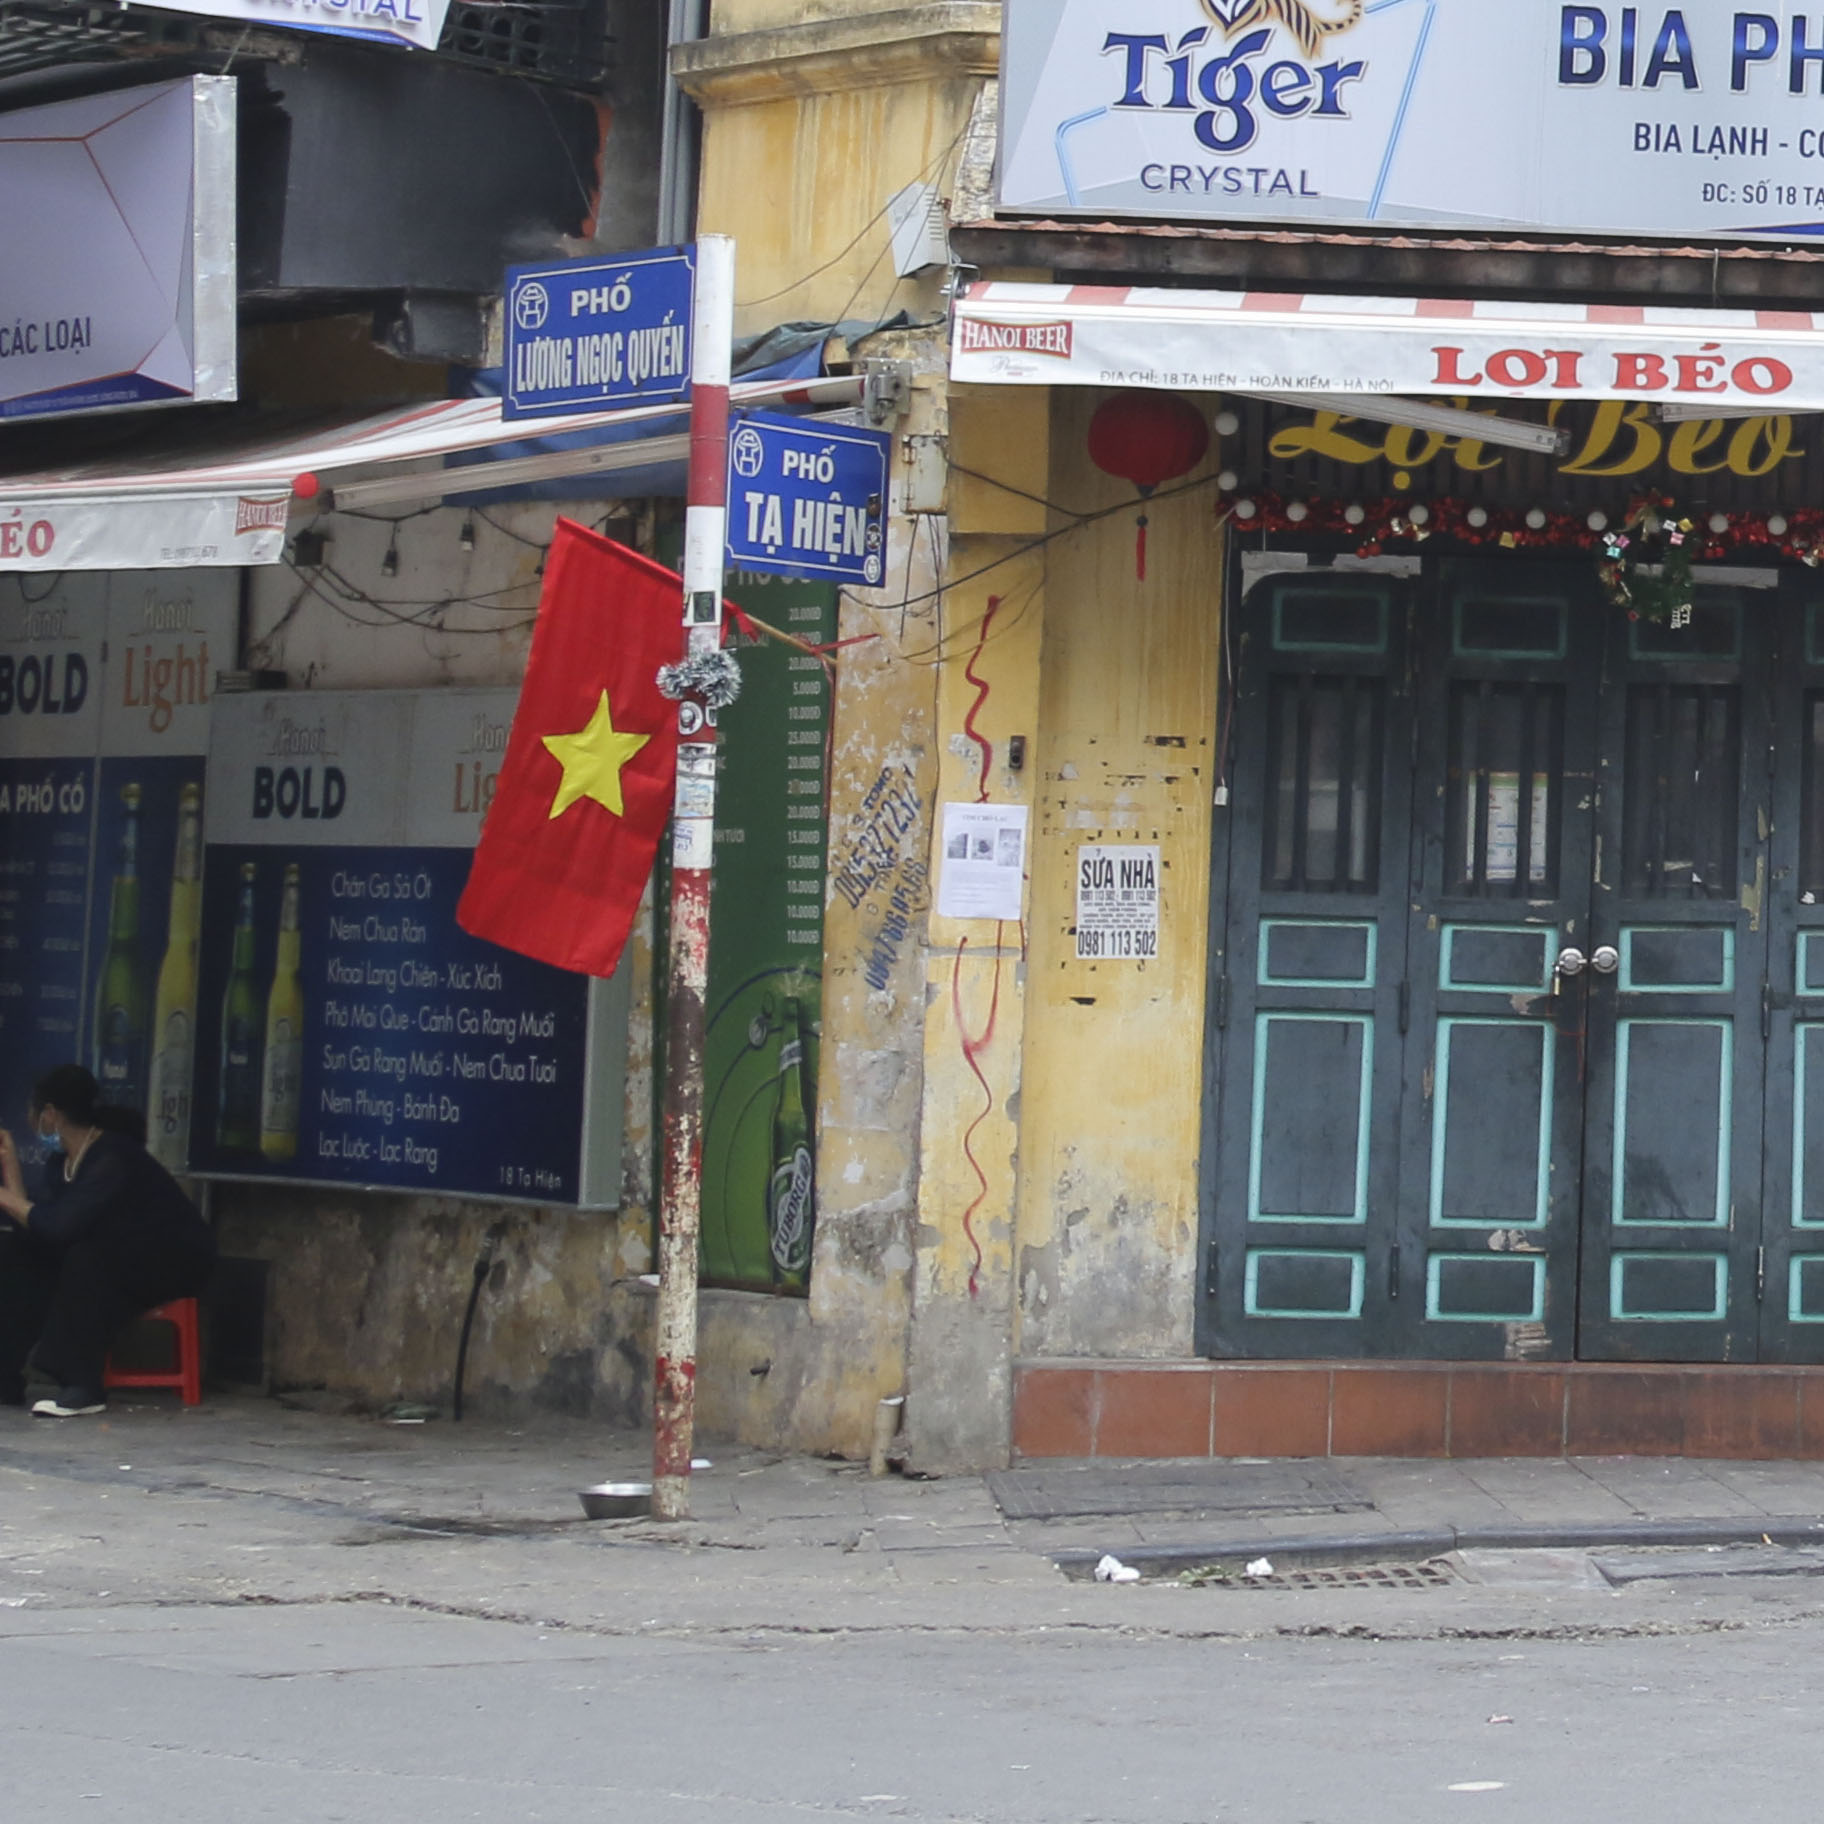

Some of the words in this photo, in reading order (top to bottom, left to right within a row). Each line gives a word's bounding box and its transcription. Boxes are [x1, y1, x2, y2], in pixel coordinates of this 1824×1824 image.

[1557, 3, 1701, 92] BIA
[1101, 26, 1368, 152] Tiger
[1633, 122, 1682, 154] BIA
[1691, 125, 1769, 162] LẠNH
[1140, 163, 1319, 197] CRYSTAL
[1702, 181, 1737, 205] ĐC:
[1742, 177, 1770, 206] SỐ
[1775, 184, 1798, 207] 18
[571, 271, 632, 317] PHỐ
[45, 315, 92, 354] LOẠI
[516, 333, 573, 393] LƯƠNG
[577, 334, 624, 393] NGỌC
[628, 309, 684, 383] QUYẾN
[964, 321, 1023, 352] HANOI
[1025, 324, 1069, 354] BEER
[1163, 373, 1178, 384] 18
[1430, 343, 1584, 395] LỢI
[1613, 342, 1793, 395] BÉO
[782, 444, 836, 483] PHỐ
[0, 508, 55, 558] ÉO
[745, 492, 782, 555] TẠ
[792, 492, 867, 564] HIỆN
[123, 641, 209, 733] Light
[252, 765, 346, 819] BOLD
[1081, 847, 1115, 889] SỬA
[1120, 852, 1155, 889] NHÀ
[1077, 930, 1105, 956] 0981
[1111, 930, 1131, 956] 113
[1134, 930, 1156, 956] 502
